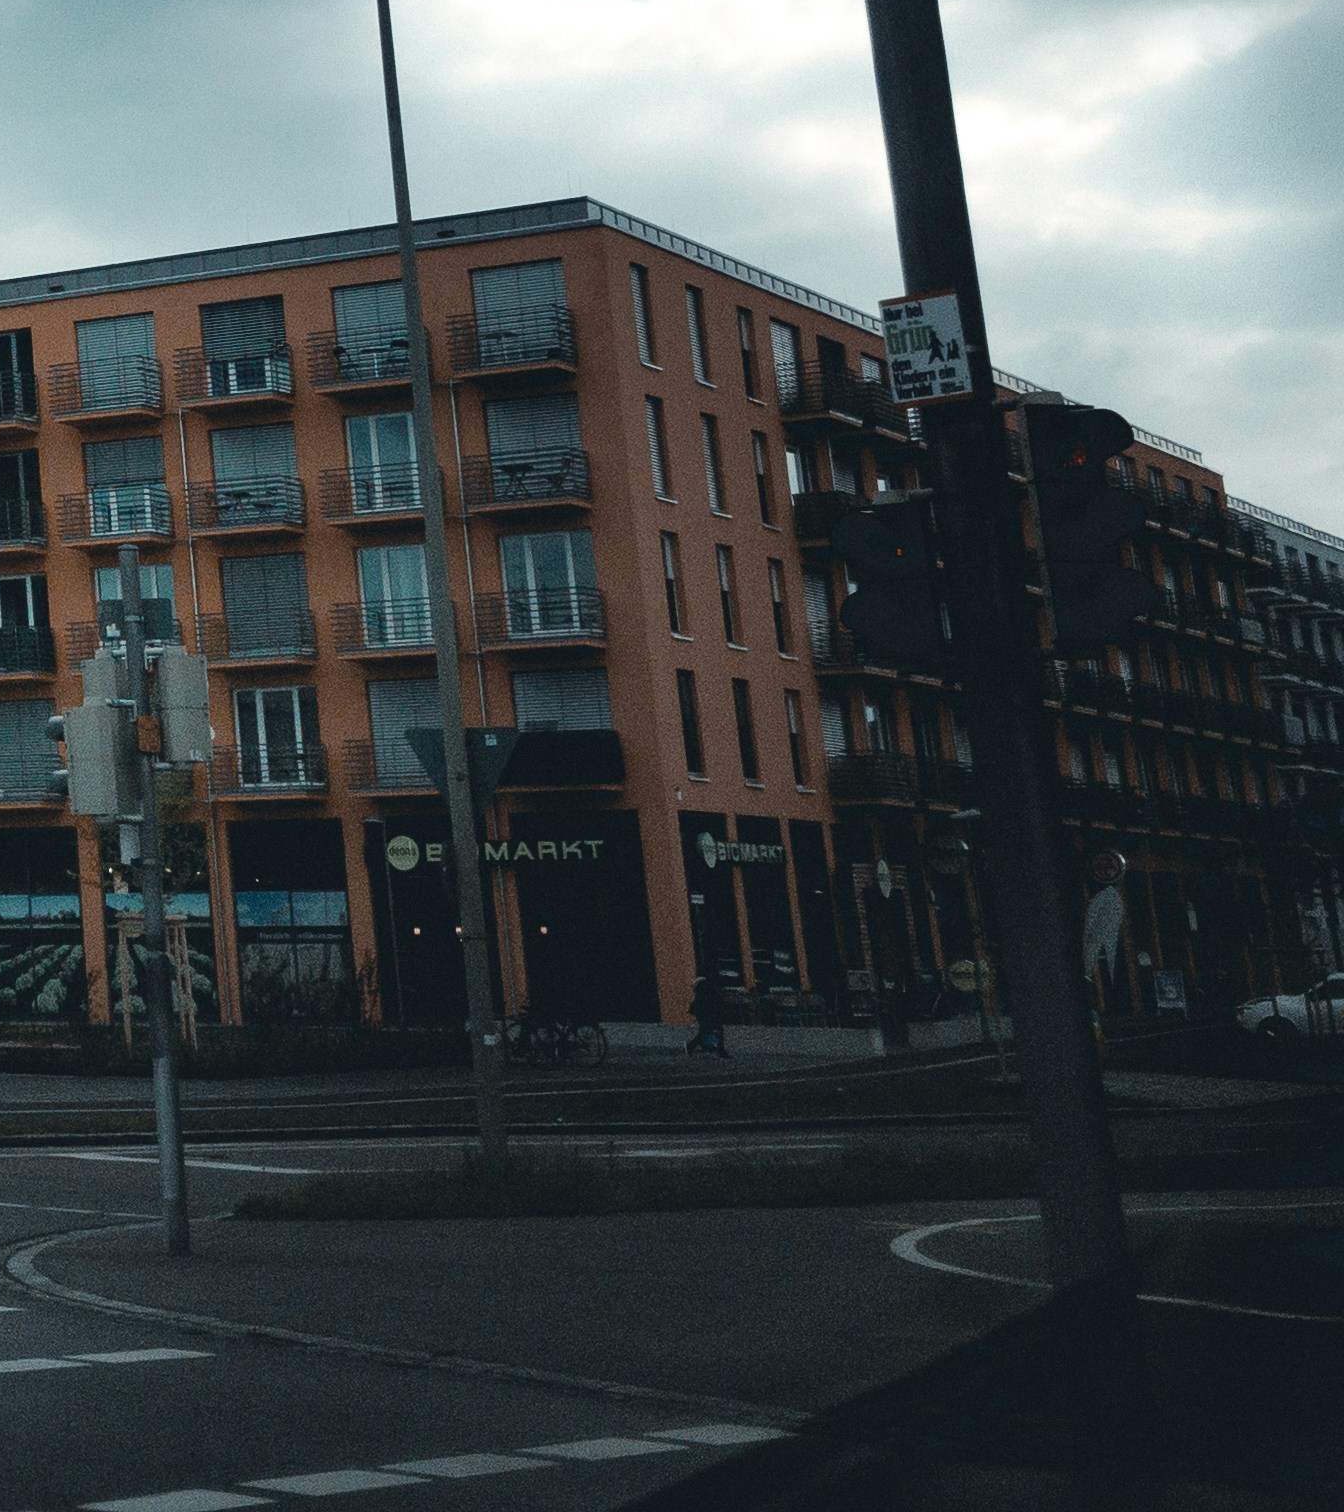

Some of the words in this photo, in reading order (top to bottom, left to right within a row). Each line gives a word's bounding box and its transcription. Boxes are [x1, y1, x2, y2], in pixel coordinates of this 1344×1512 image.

[883, 308, 903, 322] Nur
[905, 302, 923, 318] bei
[885, 320, 933, 355] Grün
[892, 359, 912, 372] den
[894, 369, 937, 386] Kindern
[425, 840, 604, 862] BMARKT
